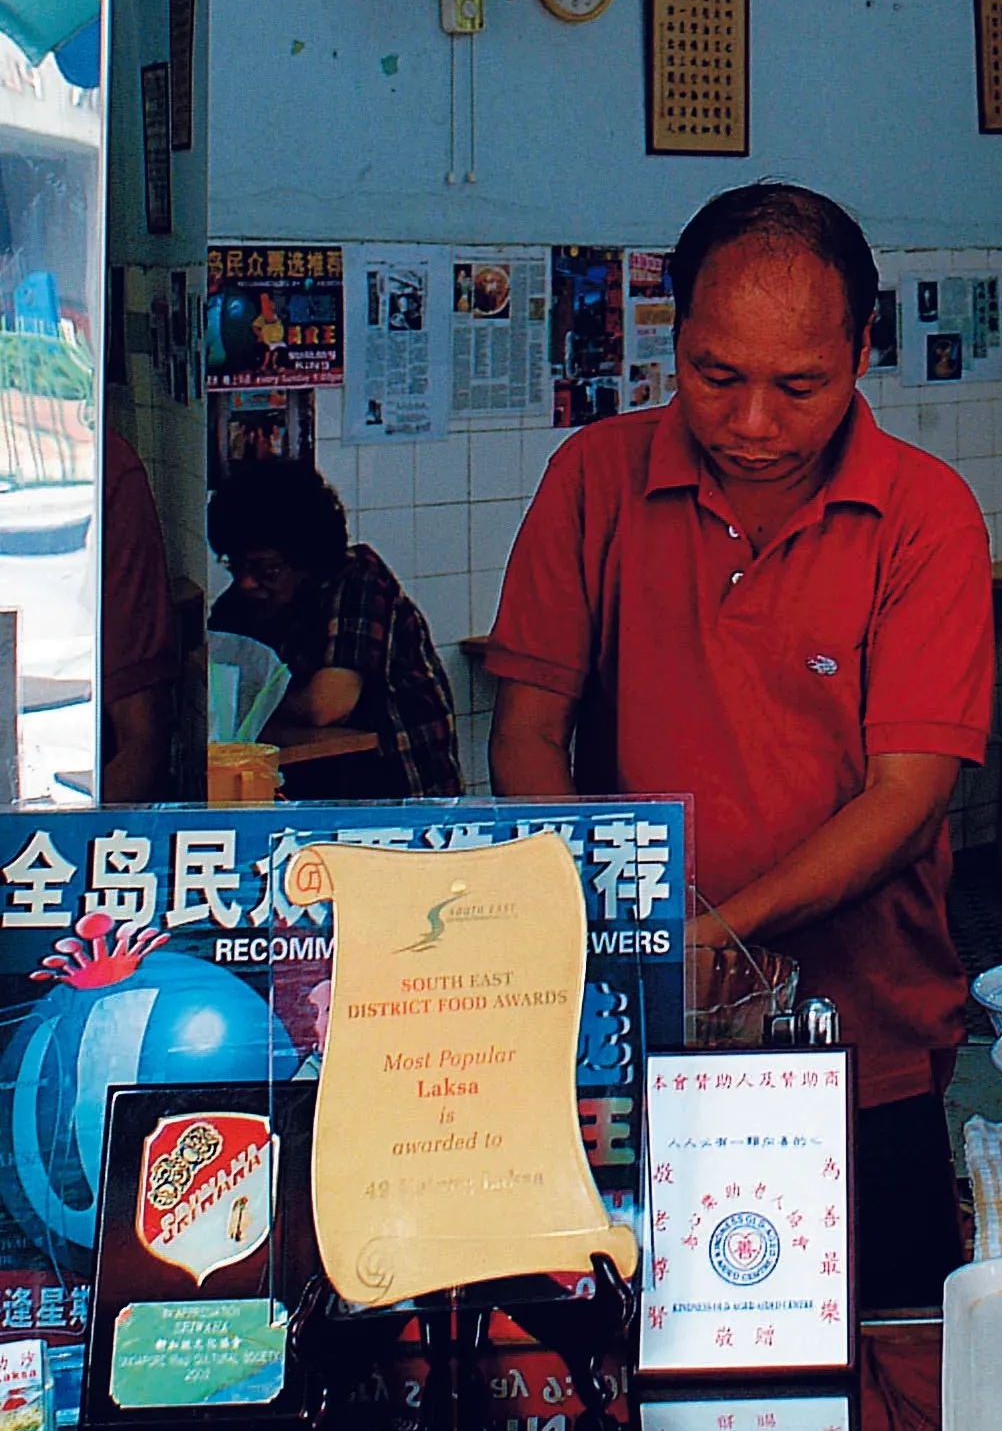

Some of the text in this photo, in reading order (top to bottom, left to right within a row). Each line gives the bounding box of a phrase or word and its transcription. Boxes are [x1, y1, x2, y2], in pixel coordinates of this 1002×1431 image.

[2, 821, 670, 929] 全岛民众荐
[216, 937, 336, 962] RECOMM
[400, 971, 514, 993] SOUTH EAST
[348, 990, 568, 1018] DISTRICT FOOD AWARDS
[384, 1045, 517, 1072] Most Popular
[417, 1078, 479, 1098] Laksa
[440, 1106, 455, 1124] is
[392, 1132, 503, 1156] awarded to
[0, 1283, 91, 1328] 逢星期
[0, 1370, 37, 1383] aksa
